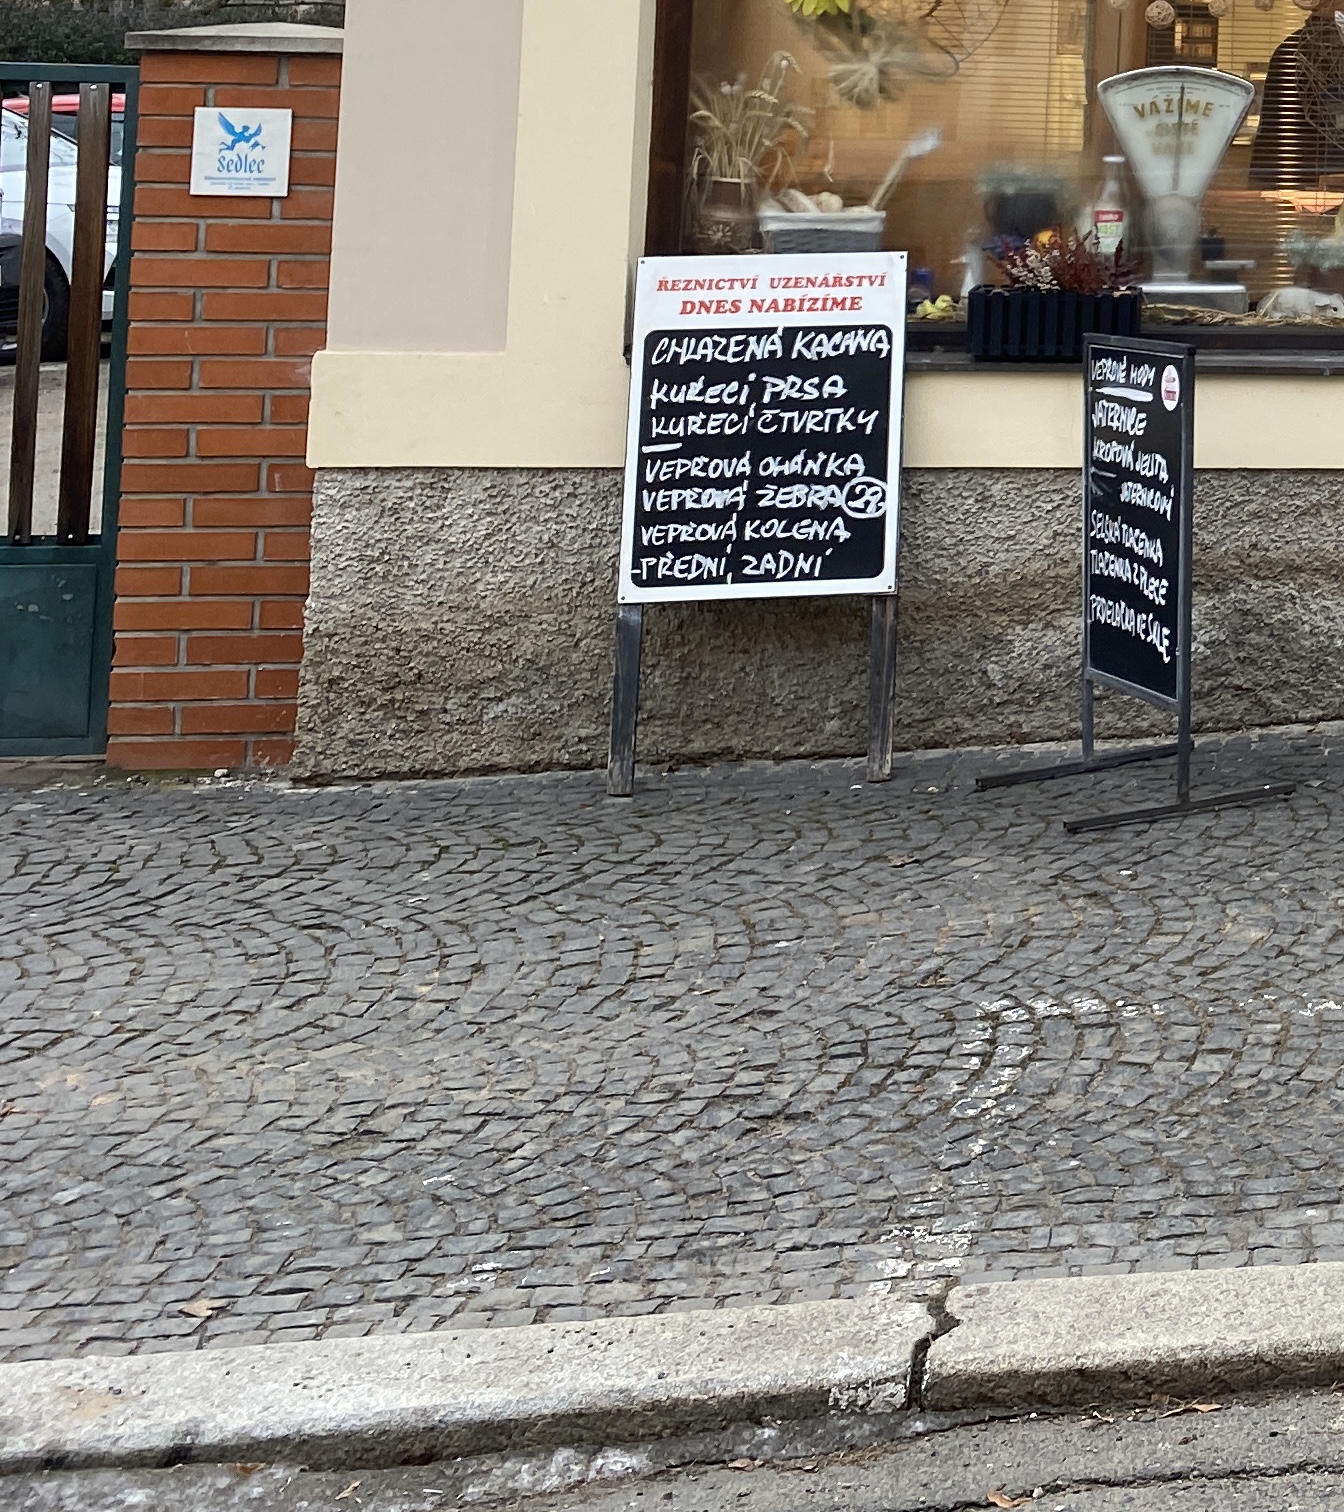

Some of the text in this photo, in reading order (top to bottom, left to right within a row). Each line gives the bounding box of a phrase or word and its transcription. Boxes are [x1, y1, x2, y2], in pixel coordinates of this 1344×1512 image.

[657, 272, 888, 292] ŘEZNICTVÍ UZENÁŘSTVÍ
[680, 293, 863, 315] DNES NABÍZÍME
[651, 326, 891, 365] CHLAZENÁ KACHNA
[650, 373, 848, 409] KUŘECÍ PRSA
[652, 402, 880, 437] KUŘECÍ ČTVRTKY
[645, 450, 751, 483] VEPŘOVÁ
[642, 480, 748, 512] VEPŘOVÁ
[756, 484, 843, 510] ŽEBRA
[641, 513, 852, 546] VEPŘOVÁ KOLENA
[741, 546, 833, 579] ZADNÍ
